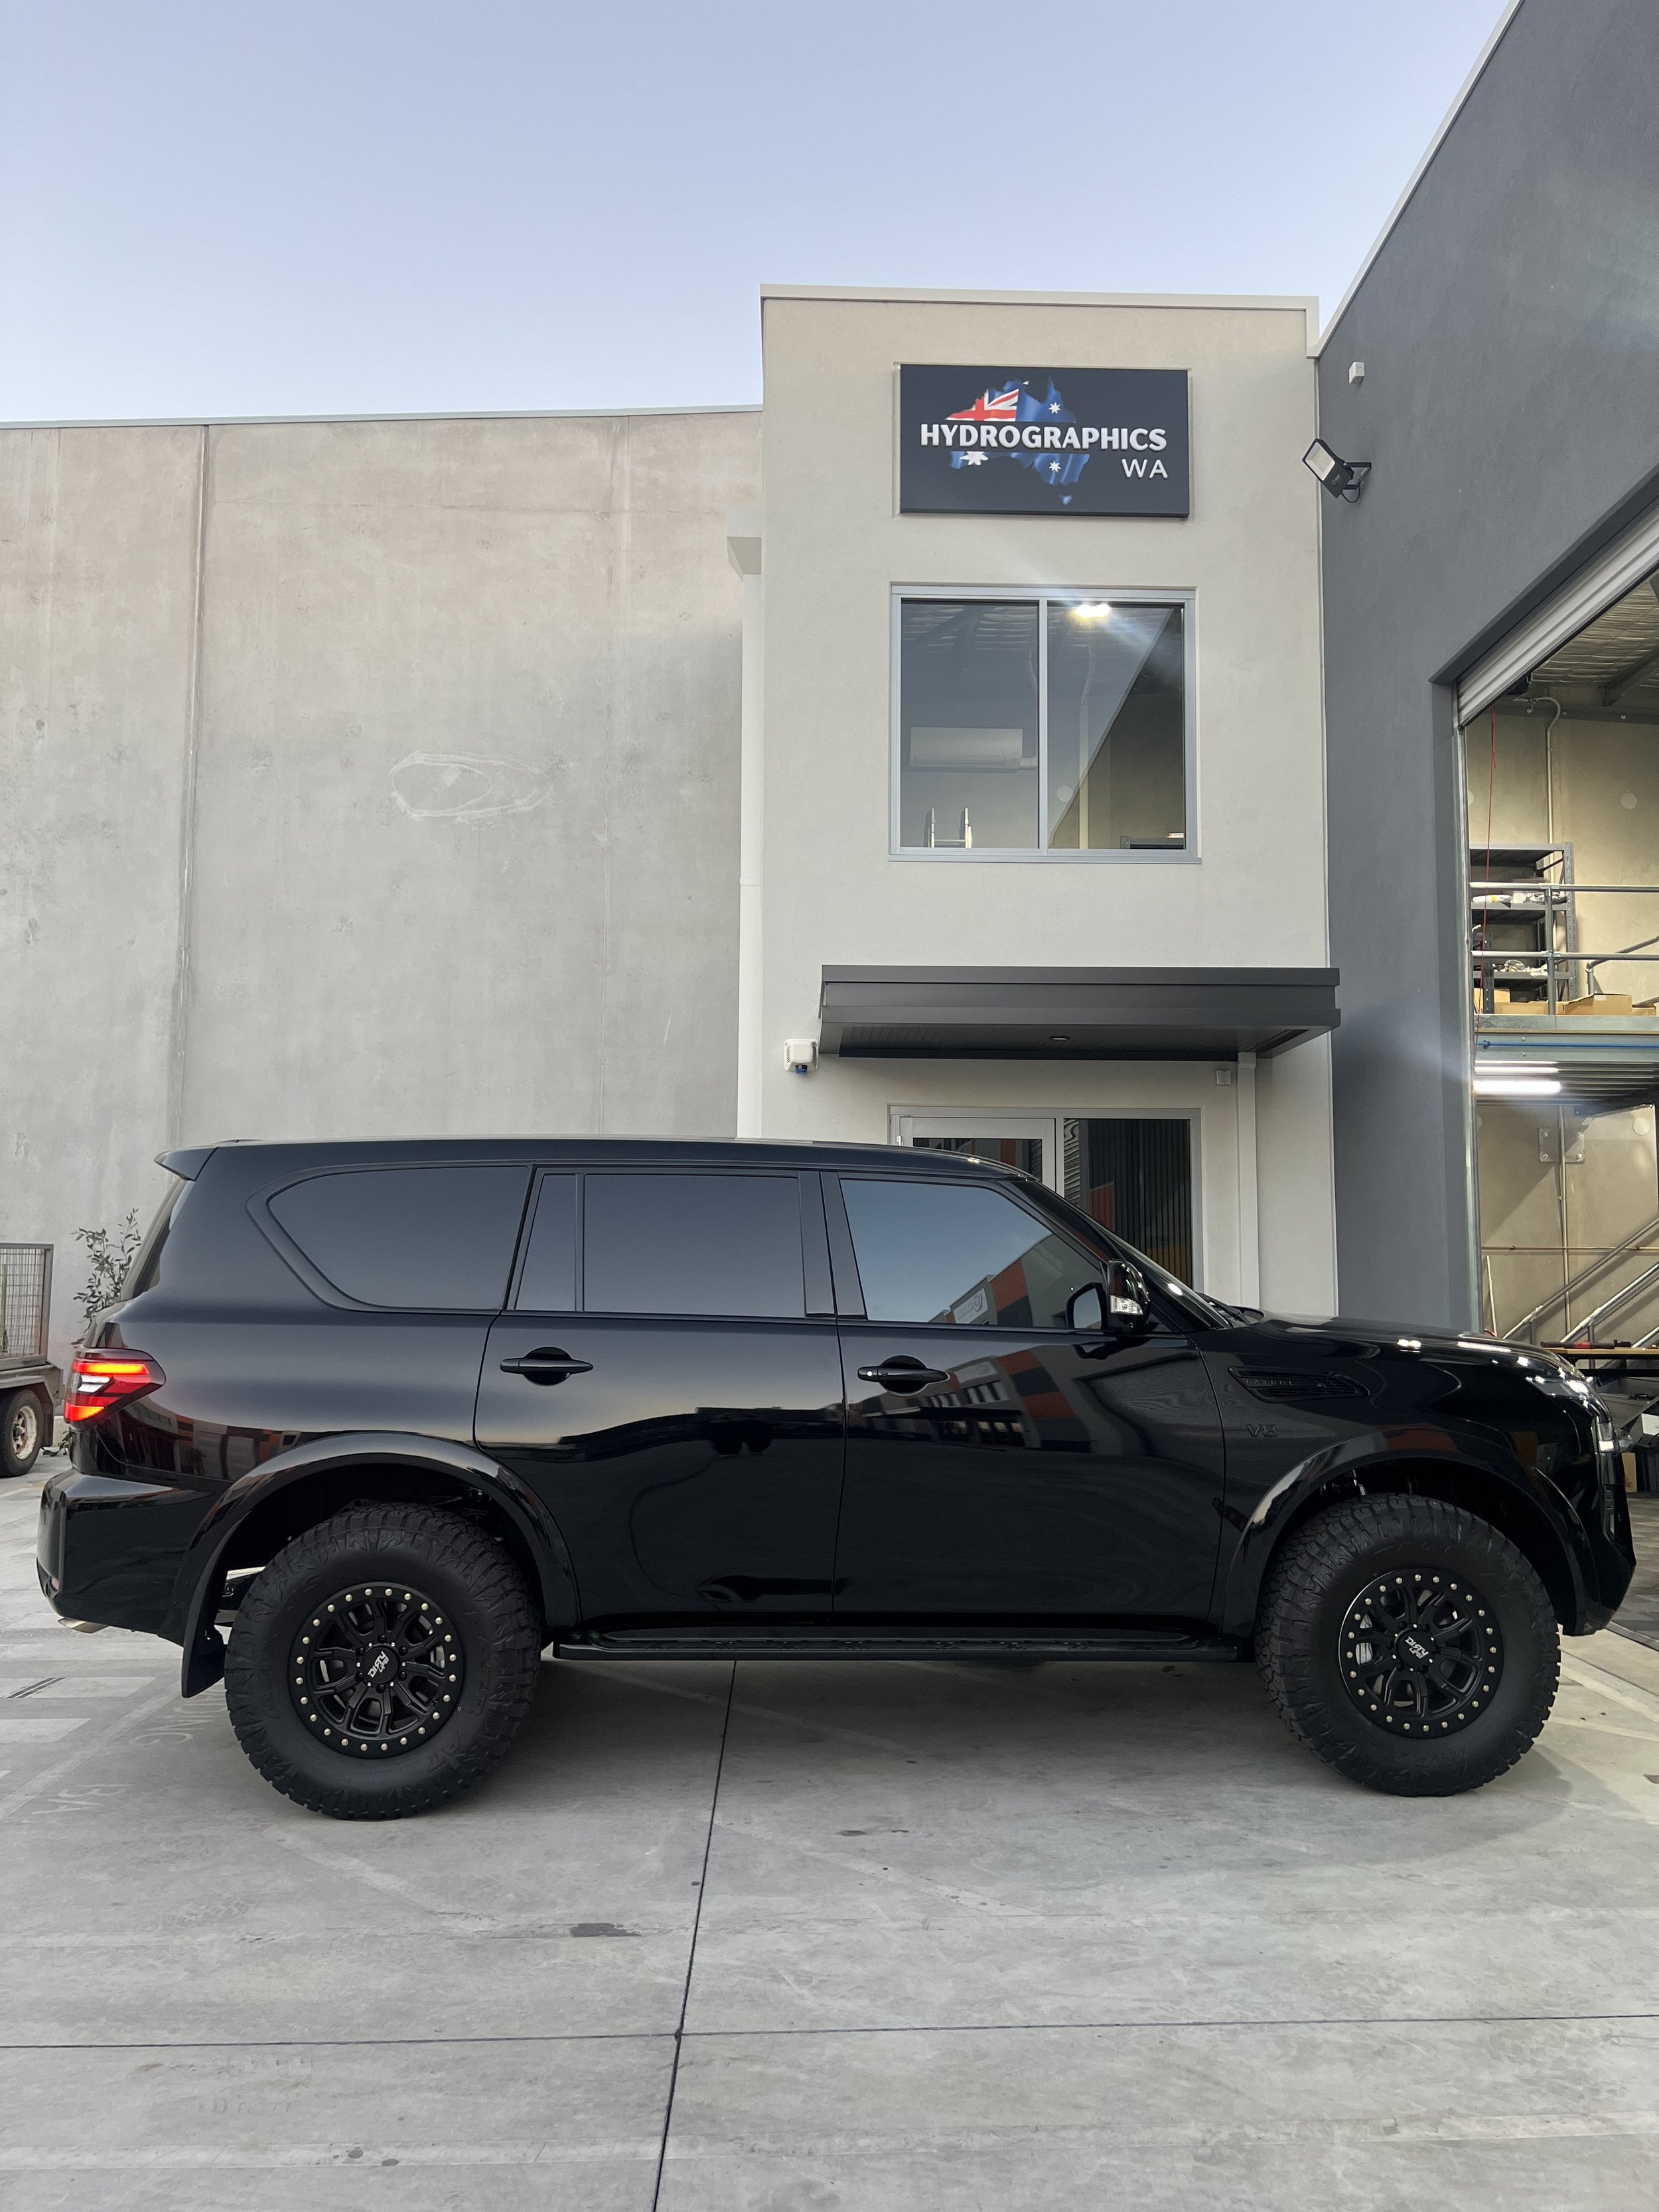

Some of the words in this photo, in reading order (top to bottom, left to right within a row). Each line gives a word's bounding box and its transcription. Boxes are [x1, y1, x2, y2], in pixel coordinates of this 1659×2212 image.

[920, 423, 1167, 451] HYDROGRAPHICS
[1121, 459, 1169, 479] WA
[1246, 1424, 1278, 1438] V8
[1405, 1636, 1429, 1657] DIRTY
[367, 1651, 387, 1678] DIRTY
[131, 1682, 226, 1745] ADING
